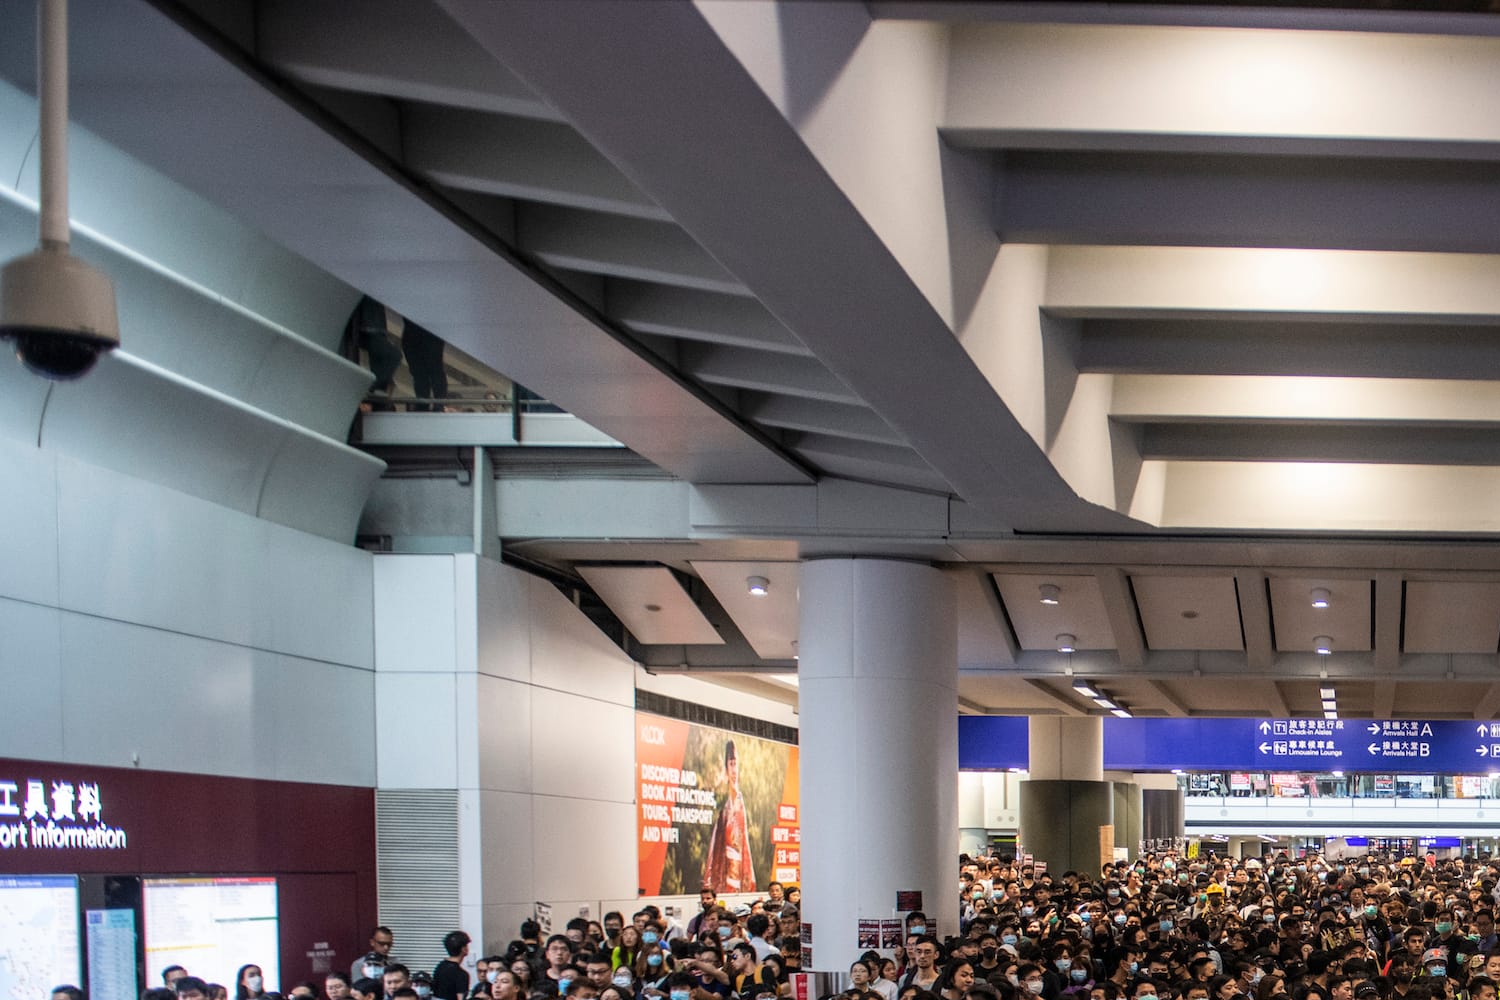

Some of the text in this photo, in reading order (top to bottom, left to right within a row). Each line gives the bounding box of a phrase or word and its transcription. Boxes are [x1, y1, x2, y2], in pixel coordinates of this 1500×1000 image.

[1420, 722, 1433, 737] A
[1320, 749, 1343, 757] Lounge
[1420, 743, 1430, 757] B
[641, 763, 696, 787] DISCOVER AND
[641, 783, 717, 809] BOOK ATTRACTIONS,
[641, 803, 713, 825] TOURS, TRANSPORT
[30, 819, 127, 848] information
[642, 825, 679, 843] AND WIFI
